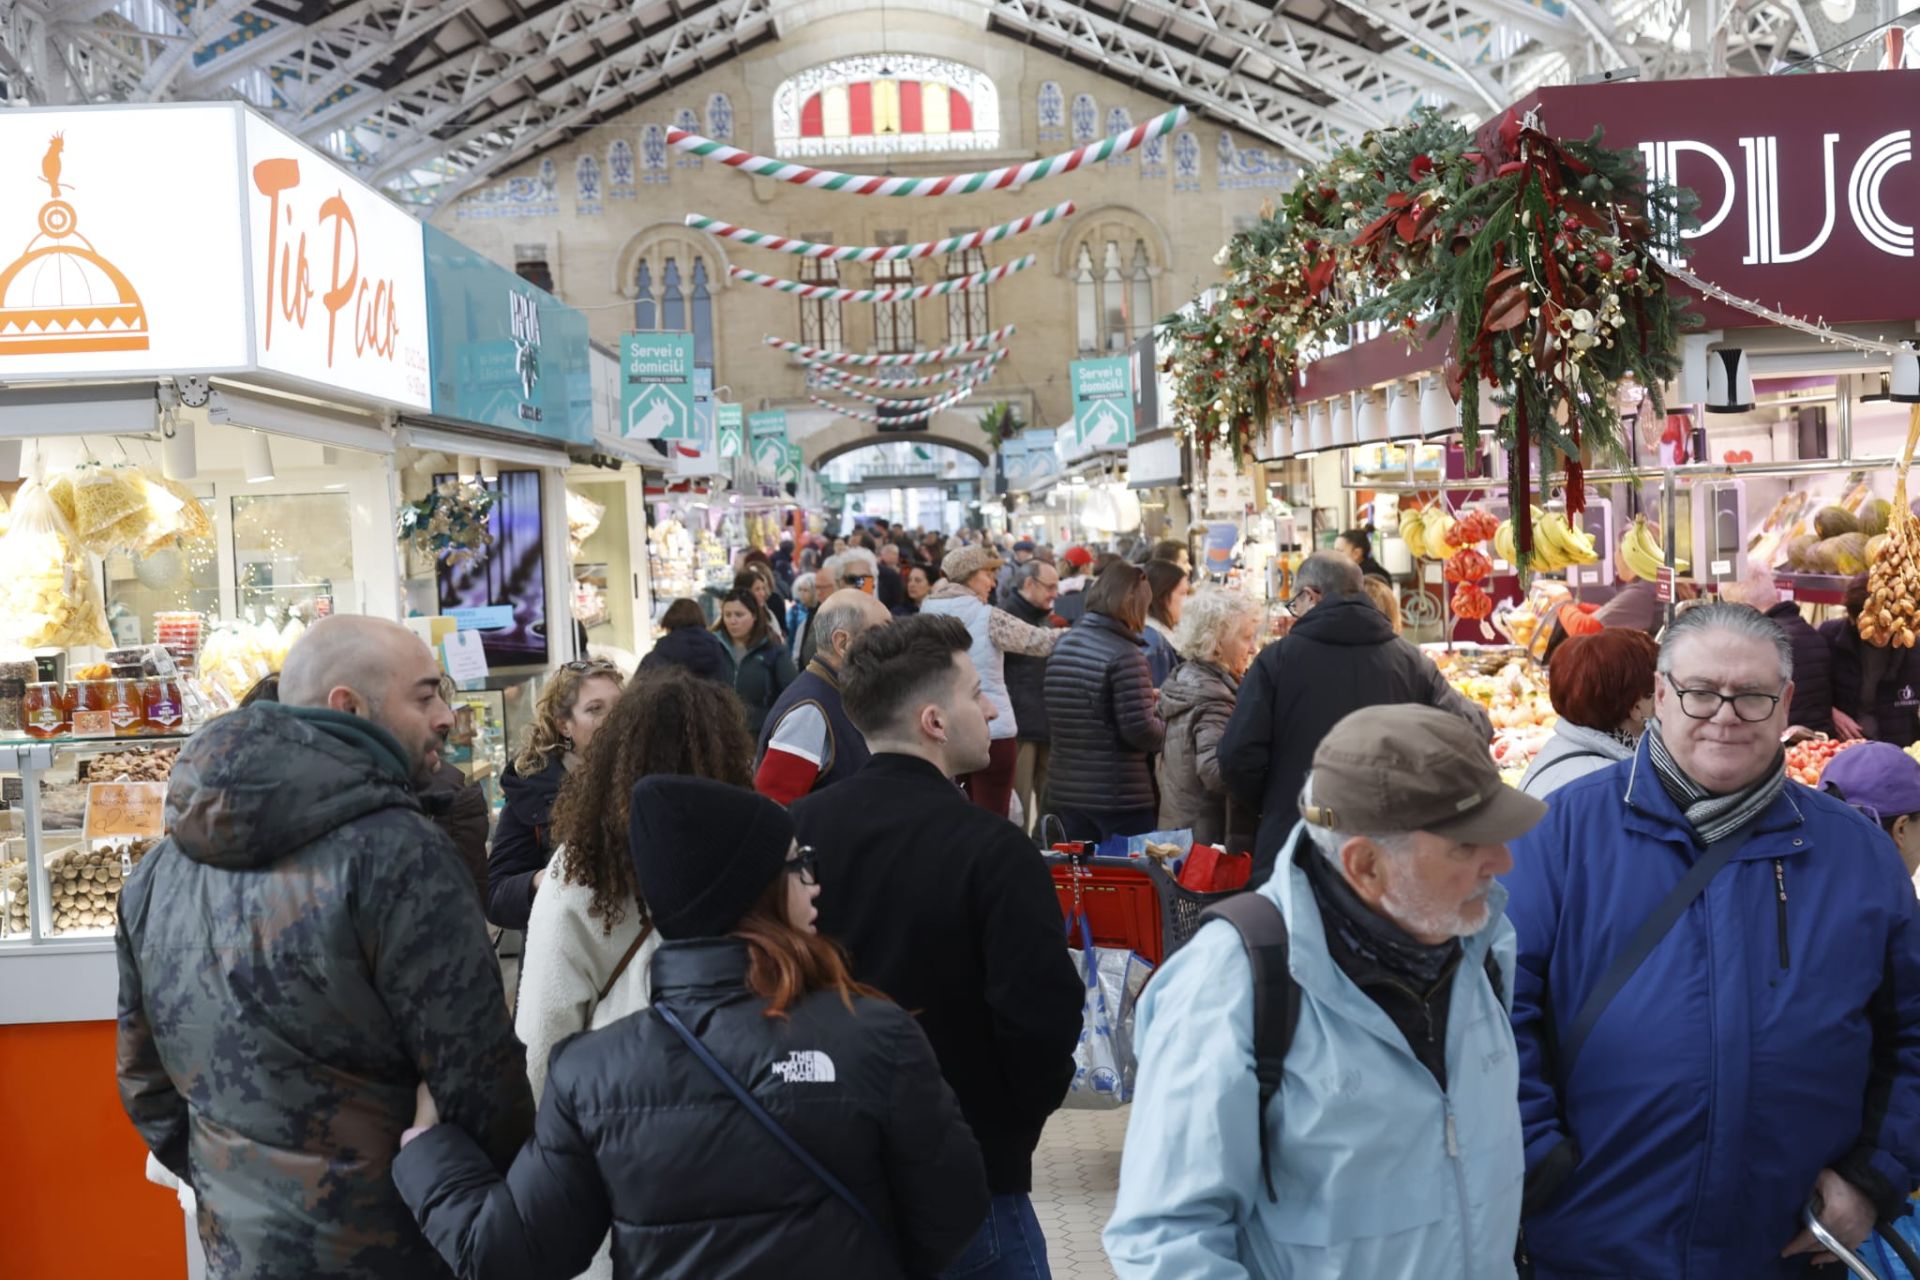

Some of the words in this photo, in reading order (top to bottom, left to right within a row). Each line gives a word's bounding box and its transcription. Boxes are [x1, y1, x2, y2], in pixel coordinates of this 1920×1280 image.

[252, 157, 314, 352] Tio
[319, 189, 400, 369] Paco
[630, 342, 672, 358] Servei
[675, 346, 684, 358] a
[630, 359, 684, 374] domicili
[1079, 365, 1113, 380] Servei
[1079, 378, 1123, 393] domicili
[788, 1050, 814, 1062] THE
[771, 1060, 814, 1075] NORTH
[783, 1072, 814, 1083] FACE
